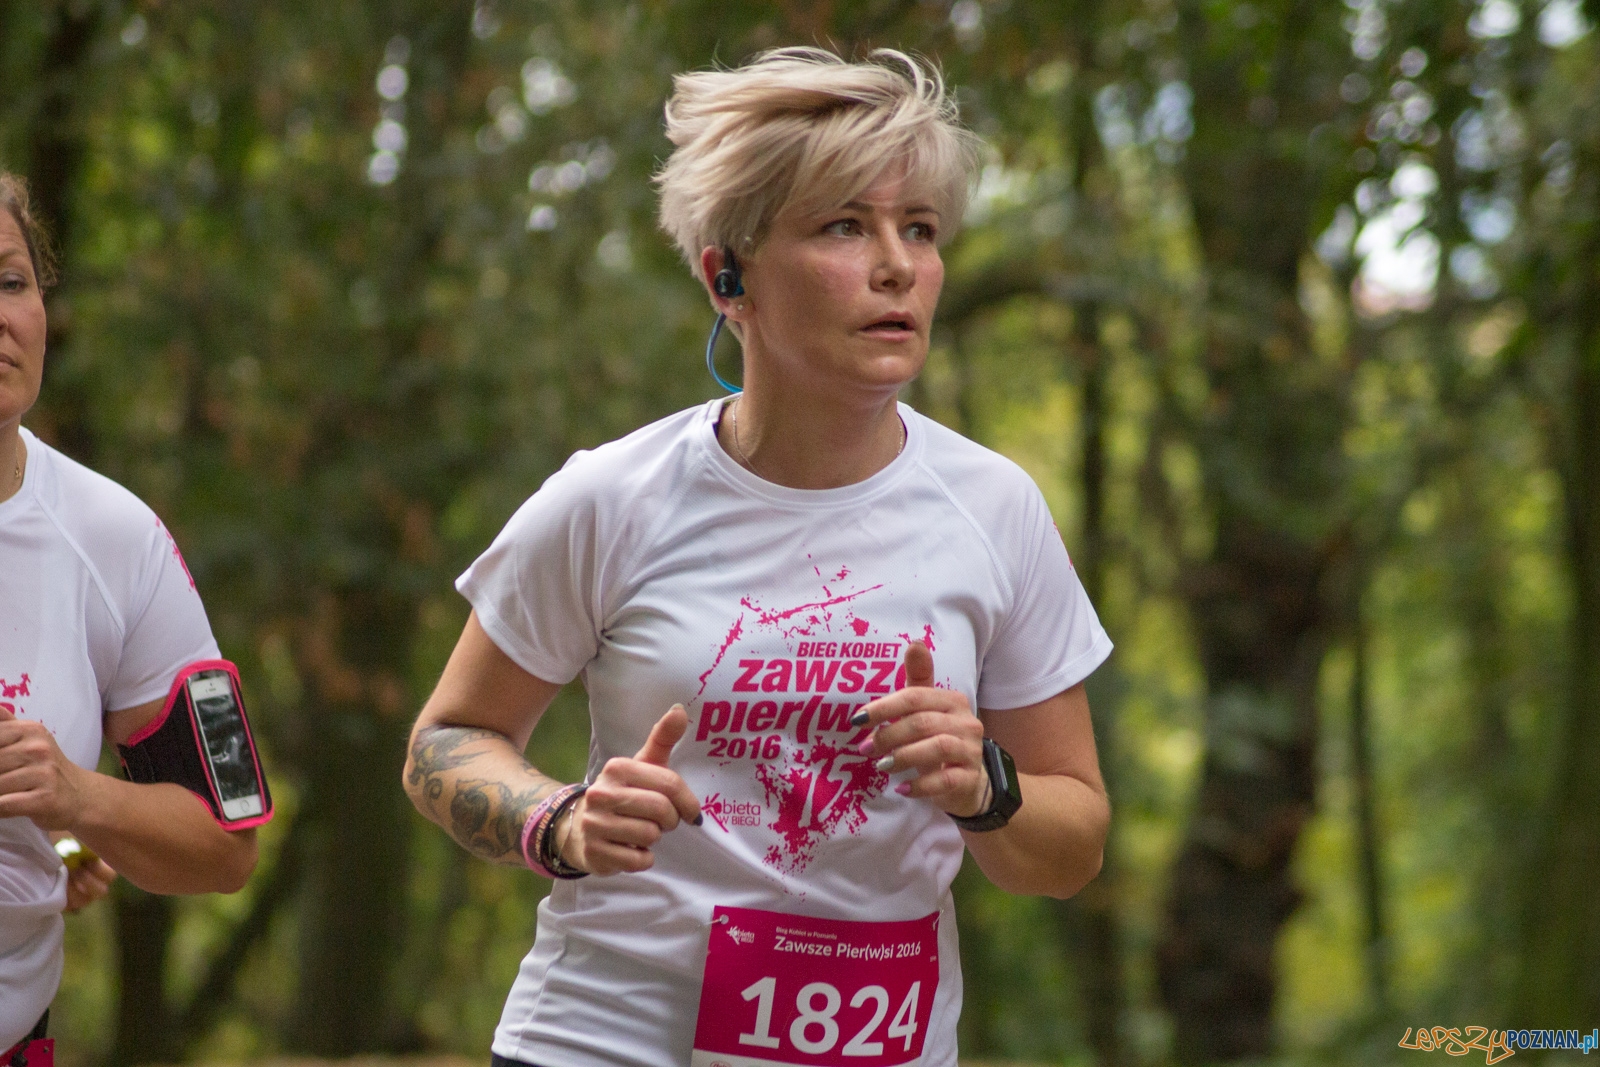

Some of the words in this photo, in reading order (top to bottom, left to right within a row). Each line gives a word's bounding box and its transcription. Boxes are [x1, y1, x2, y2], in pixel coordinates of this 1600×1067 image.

[796, 642, 836, 658] BIEG
[839, 642, 902, 659] KOBIET
[707, 735, 782, 760] 2016
[731, 816, 761, 826] BIEGU
[774, 936, 832, 957] Zawsze
[836, 942, 894, 961] Pier(w)si
[896, 941, 921, 958] 2016
[738, 976, 921, 1057] 1824
